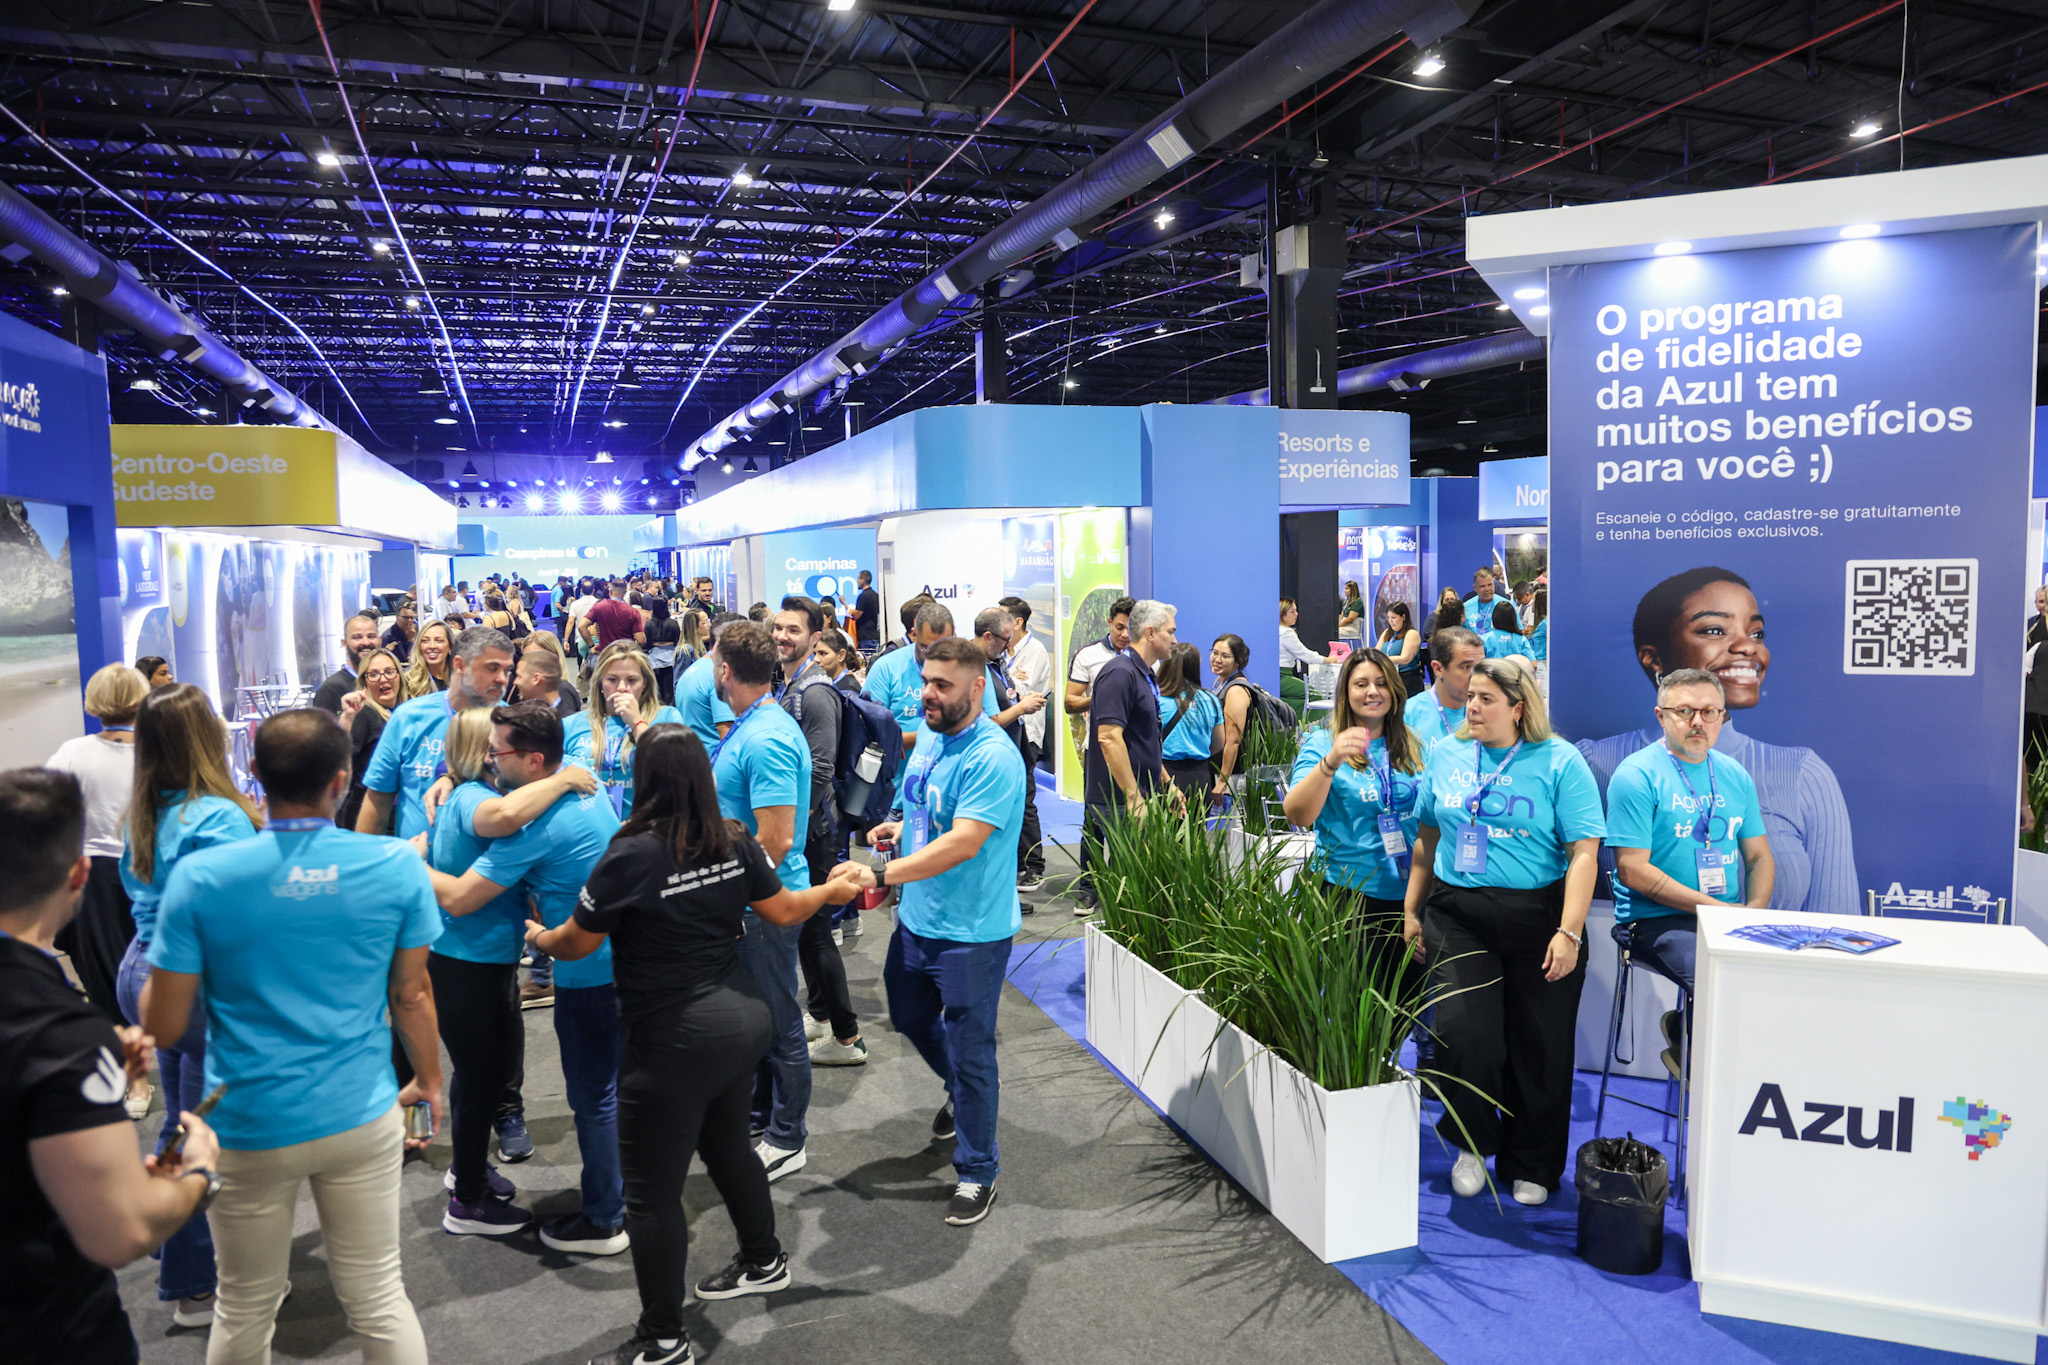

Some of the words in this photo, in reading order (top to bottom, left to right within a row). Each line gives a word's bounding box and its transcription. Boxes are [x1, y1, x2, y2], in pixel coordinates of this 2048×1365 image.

[1596, 304, 1627, 336] O
[1640, 293, 1843, 340] programa
[1596, 342, 1644, 373] de
[1655, 326, 1863, 369] fidelidade
[1596, 379, 1644, 410] da
[1655, 372, 1743, 407] Azul
[1756, 372, 1838, 401] tem
[1596, 414, 1732, 447] muitos
[1745, 400, 1973, 440] benefícios
[1358, 437, 1371, 452] e
[1279, 458, 1399, 483] Experiências
[1596, 457, 1684, 491] para
[1696, 446, 1795, 480] você
[1809, 444, 1834, 484] ;)
[1516, 484, 1549, 507] Nor
[1596, 511, 1661, 525] Escaneie
[1666, 513, 1677, 523] o
[1681, 509, 1739, 527] código,
[1743, 506, 1839, 522] cadastre-se
[1843, 503, 1961, 522] gratuitamente
[1596, 530, 1605, 541] e
[1609, 525, 1650, 540] tenha
[1655, 525, 1732, 540] benefícios
[1737, 523, 1824, 539] exclusivos.
[785, 557, 857, 573] Campinas
[786, 577, 804, 594] tá
[922, 584, 957, 599] Azul
[903, 704, 918, 717] tá
[414, 762, 434, 778] tá
[1359, 784, 1379, 802] tá
[1443, 791, 1463, 808] tá
[1674, 819, 1693, 838] tá
[1721, 848, 1736, 865] zul
[287, 863, 339, 883] Azul
[1883, 882, 1954, 909] Azul
[1738, 1082, 1915, 1153] Azul
